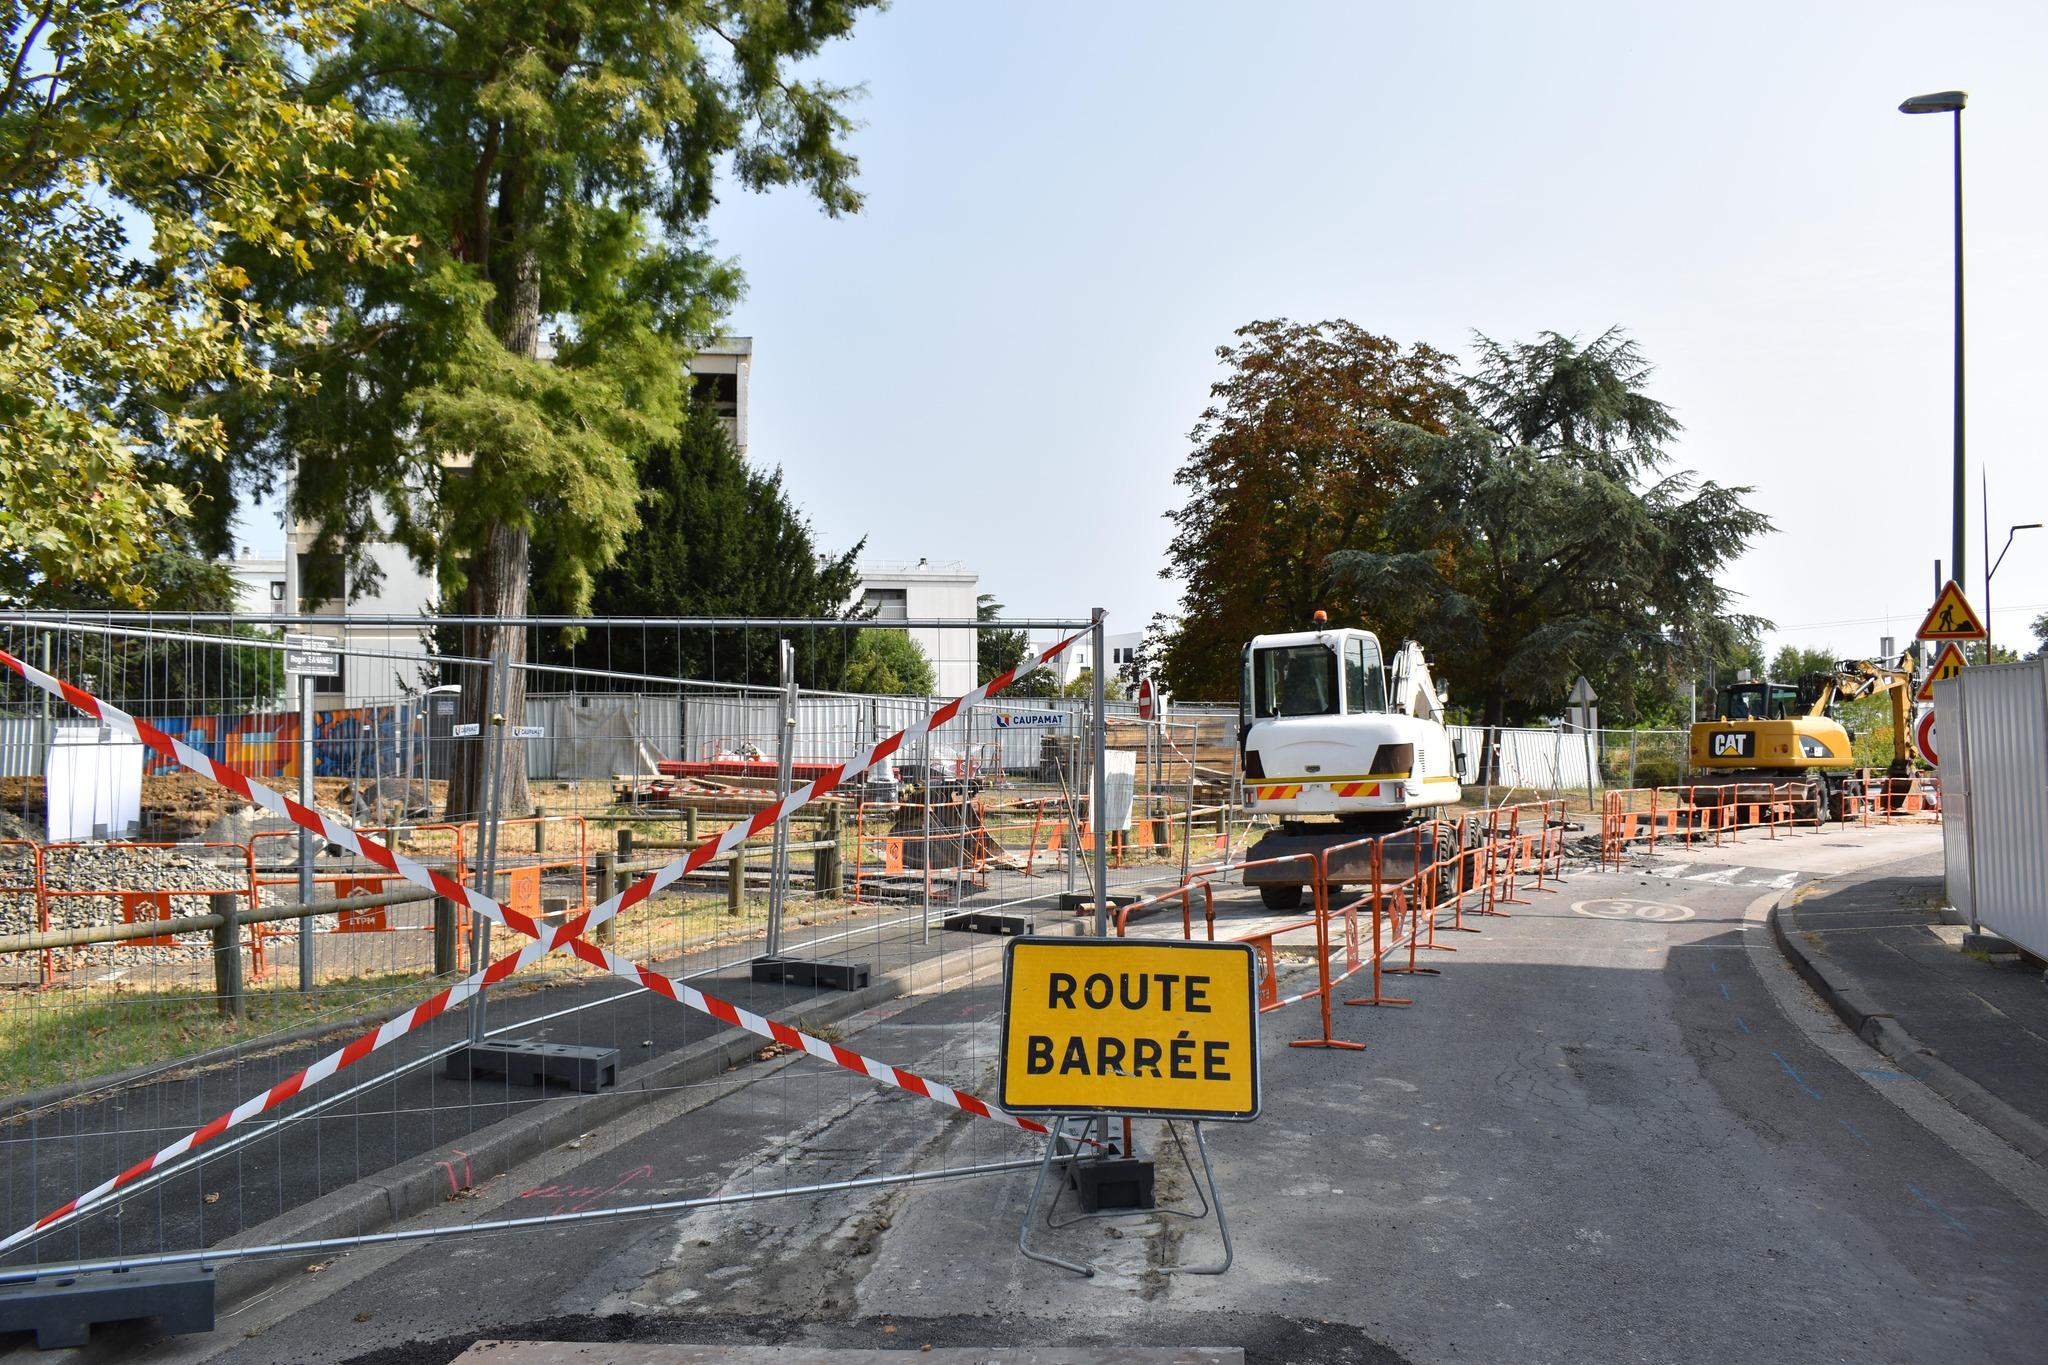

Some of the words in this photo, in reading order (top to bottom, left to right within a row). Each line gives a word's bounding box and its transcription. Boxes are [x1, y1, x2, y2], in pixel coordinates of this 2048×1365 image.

[1013, 714, 1063, 725] CAUPAMAT
[1715, 734, 1746, 756] CAT
[1598, 901, 1667, 918] 30
[349, 916, 376, 926] ETPM
[1048, 972, 1212, 1013] ROUTE
[1026, 1030, 1231, 1081] BARRÉE
